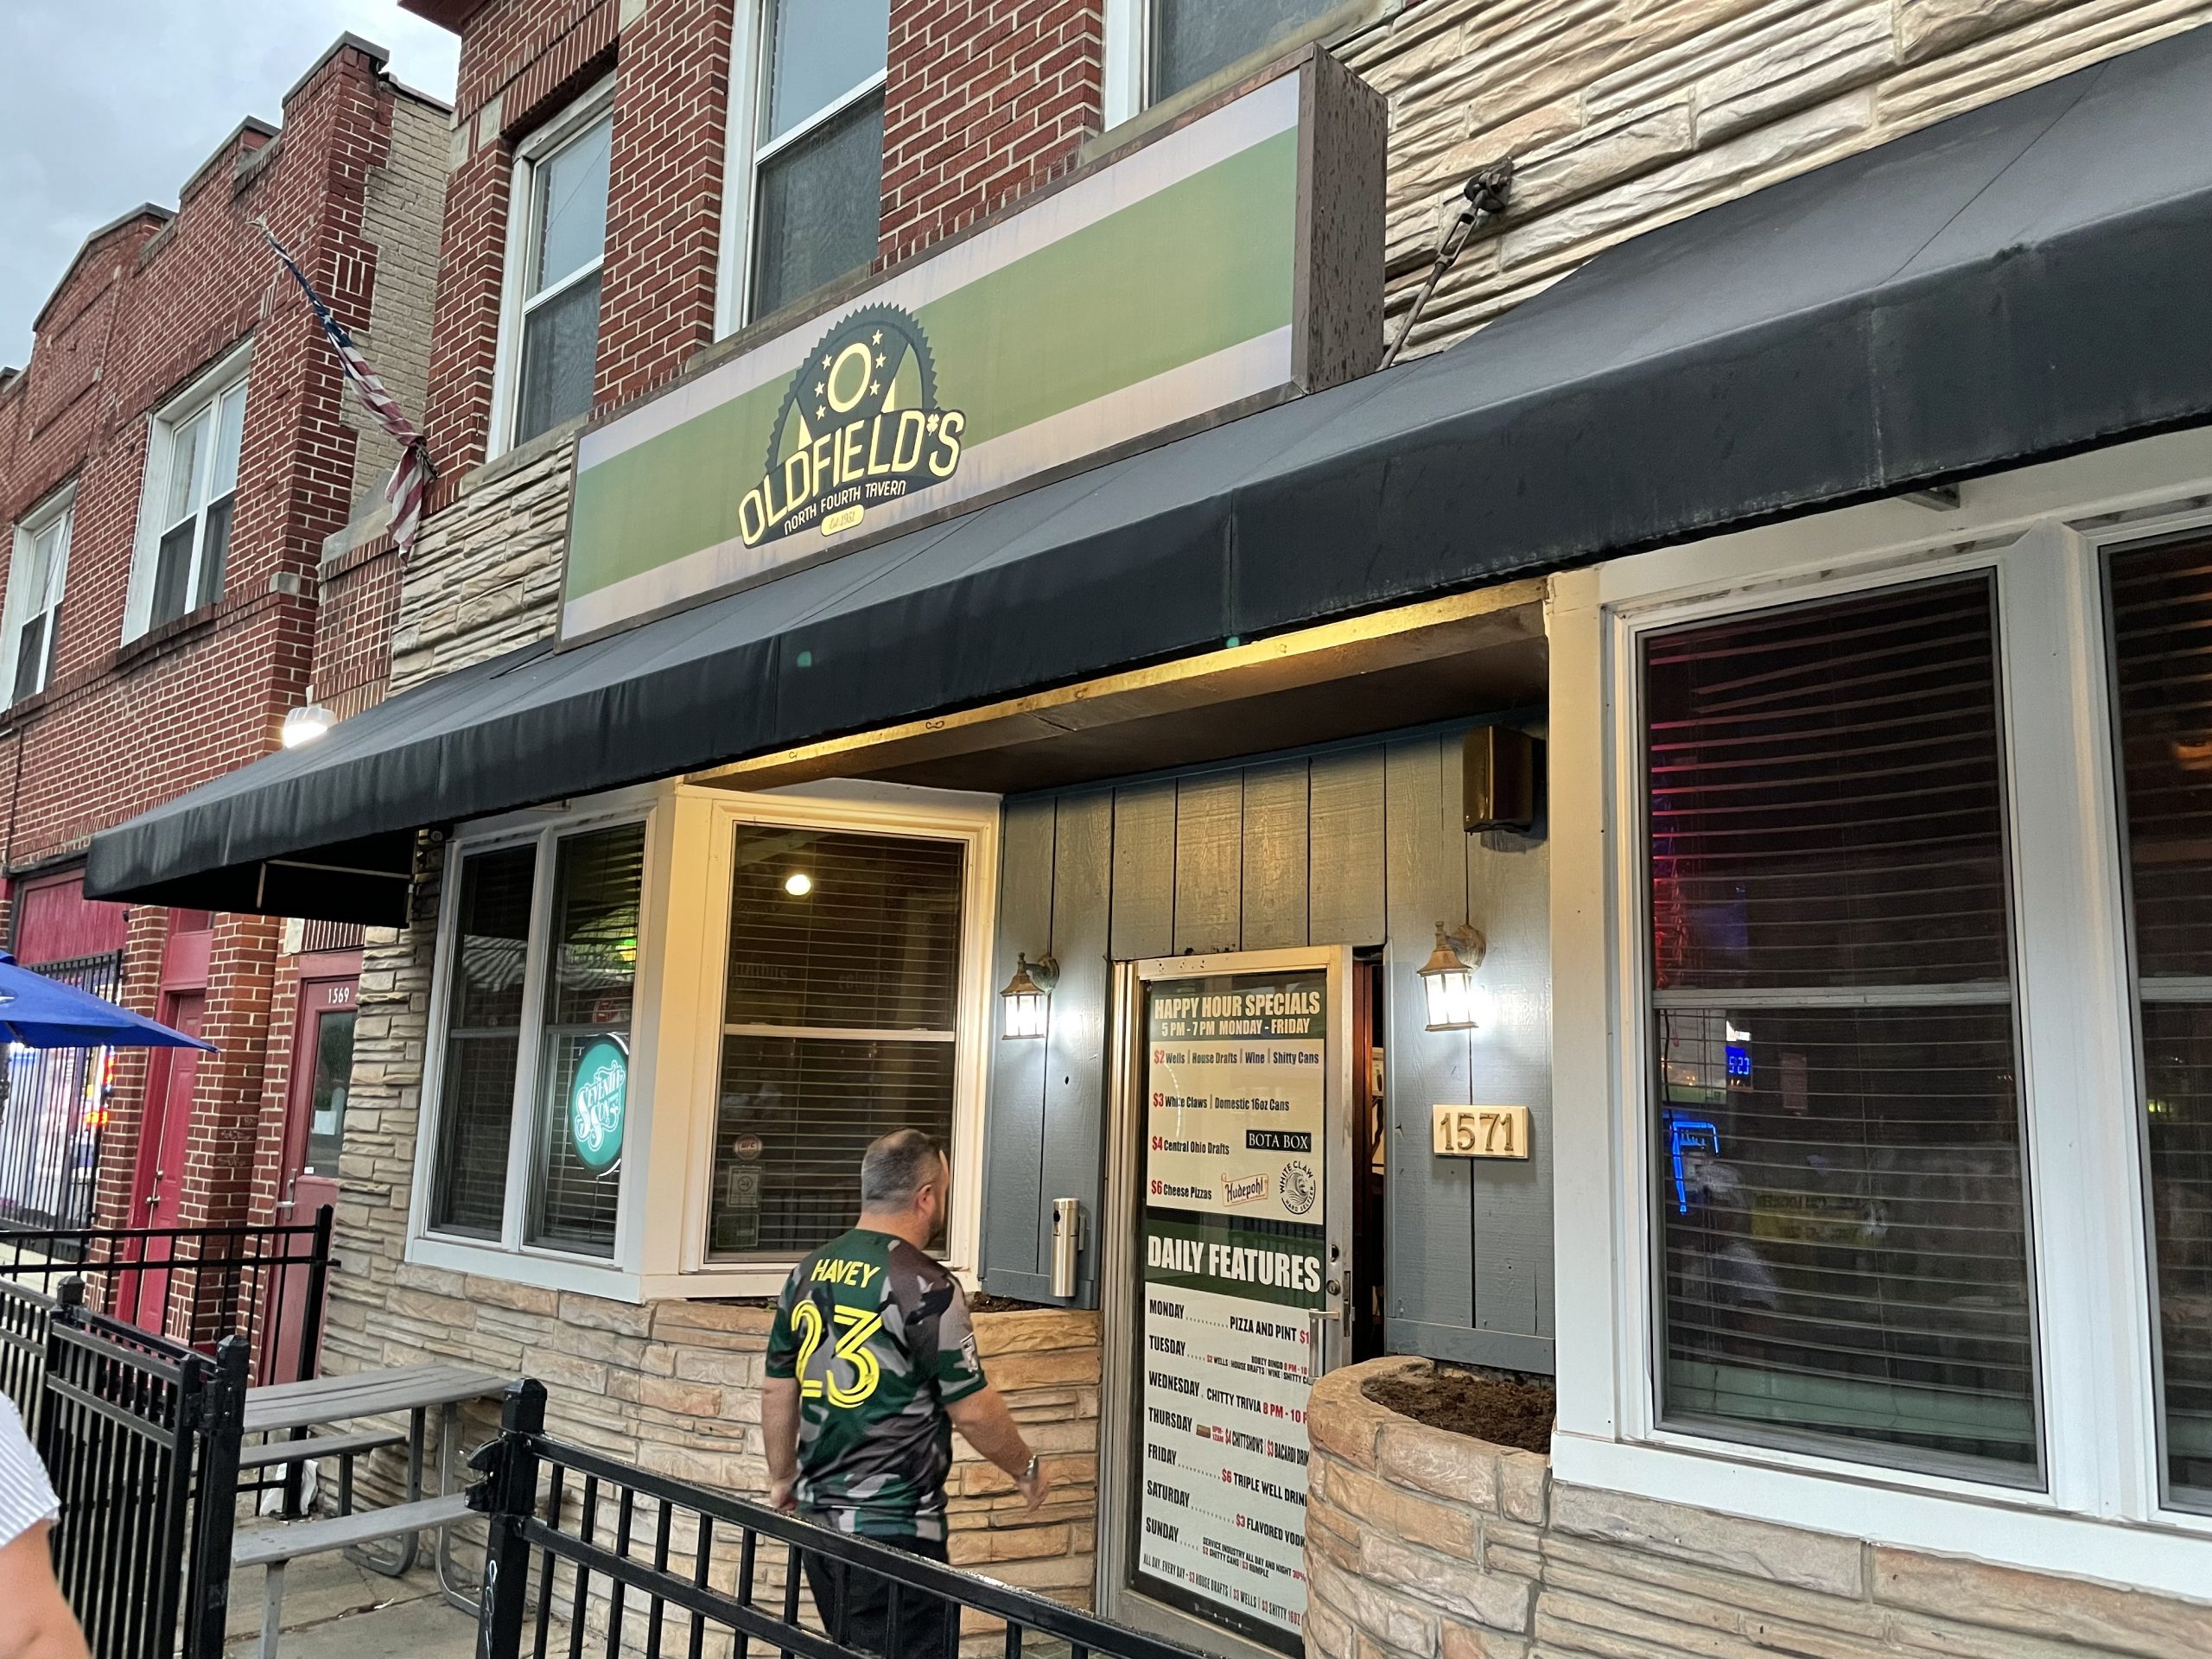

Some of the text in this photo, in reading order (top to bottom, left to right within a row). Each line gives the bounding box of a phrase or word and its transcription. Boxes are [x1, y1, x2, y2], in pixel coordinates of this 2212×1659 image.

[785, 480, 906, 536] NORTH FOURTH TAVERN
[328, 988, 349, 1003] 1569
[1154, 991, 1319, 1020] HAPPY HOUR SPECIALS
[1161, 1024, 1168, 1036] 5
[1171, 1022, 1184, 1036] PM
[1192, 1021, 1198, 1035] 7
[1200, 1020, 1215, 1035] PM
[1219, 1020, 1262, 1035] MONDAY
[1271, 1019, 1310, 1033] FRIDAY
[1154, 1050, 1319, 1065] $2 Wells House Drafts Wine Shitty Cans
[1154, 1093, 1289, 1110] $3 White Claws Domestic 16oz Cans
[1153, 1136, 1229, 1154] $4 Central Ohio Drafts
[1249, 1134, 1308, 1149] BOTA BOX
[1441, 1113, 1514, 1151] 1571
[1151, 1180, 1211, 1199] $6 Cheese Pizzas
[1280, 1160, 1313, 1193] WHITE CLAW
[1225, 1177, 1263, 1203] Hudepohl
[1286, 1199, 1298, 1211] HARD
[810, 1259, 880, 1288] HAVEY
[1147, 1235, 1320, 1293] DAILY FEATURES
[1149, 1300, 1309, 1344] MONDAY PIZZA AND PINT $1
[791, 1300, 882, 1408] 23
[1149, 1335, 1185, 1357] TUESDAY
[1214, 1357, 1228, 1366] WELLS
[1231, 1361, 1246, 1370] HOUSE
[1247, 1364, 1264, 1375] DRAFTS
[1268, 1369, 1280, 1378] WINE
[1283, 1372, 1301, 1382] SHITTY
[1288, 1363, 1296, 1372] PM
[1301, 1366, 1306, 1375] 10
[1149, 1370, 1199, 1397] WEDNESDAY
[1207, 1388, 1234, 1406] CHITTY
[1236, 1395, 1262, 1414] TRIVIA
[1263, 1402, 1268, 1414] 8
[1270, 1404, 1283, 1419] PM
[1291, 1409, 1301, 1423] 10
[1148, 1407, 1192, 1433] THURSDAY
[1274, 1442, 1296, 1464] BACARDI
[1297, 1448, 1309, 1466] DRIN
[1148, 1443, 1307, 1508] FRIDAY $6 TRIPLE WELL DRIN
[1147, 1480, 1305, 1548] SATURDAY $3 FLAVORED VODK
[1147, 1517, 1179, 1543] SUNDAY
[1203, 1536, 1221, 1552] SERVICE
[1255, 1555, 1264, 1567] DAY
[1266, 1560, 1274, 1570] AND
[1276, 1563, 1292, 1576] NIGHT
[1210, 1548, 1226, 1561] SHITTY
[1227, 1554, 1239, 1567] CANS
[1162, 1560, 1175, 1575] EVERY
[1196, 1573, 1211, 1589] HOUSE
[1211, 1579, 1229, 1597] DRAFTS
[1241, 1592, 1256, 1608] WELLS
[1269, 1602, 1287, 1623] SHITTY
